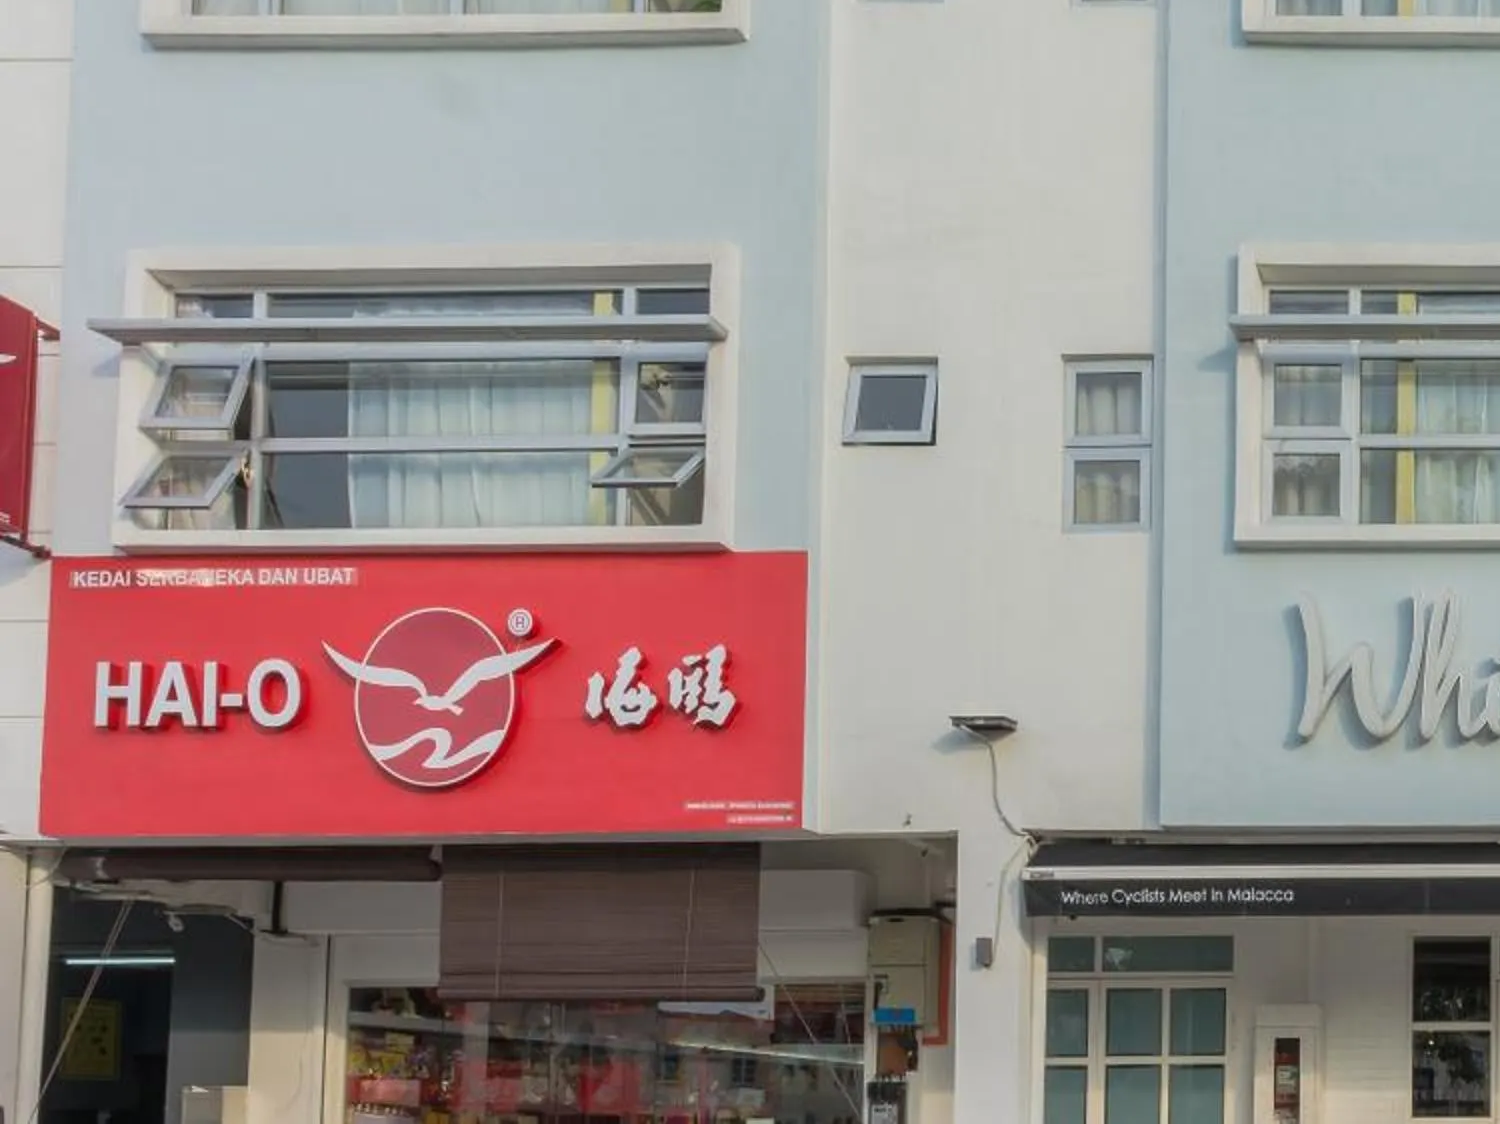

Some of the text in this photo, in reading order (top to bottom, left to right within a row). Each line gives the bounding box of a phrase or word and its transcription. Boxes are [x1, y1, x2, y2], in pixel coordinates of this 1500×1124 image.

[74, 571, 131, 588] KEDAI
[258, 567, 298, 586] DAN
[302, 566, 355, 586] UBAT
[95, 658, 301, 727] HAI-O
[1061, 890, 1108, 905] Where
[1112, 888, 1165, 907] Cyclists
[1168, 888, 1207, 903] Meet
[1227, 887, 1294, 903] Malacca
